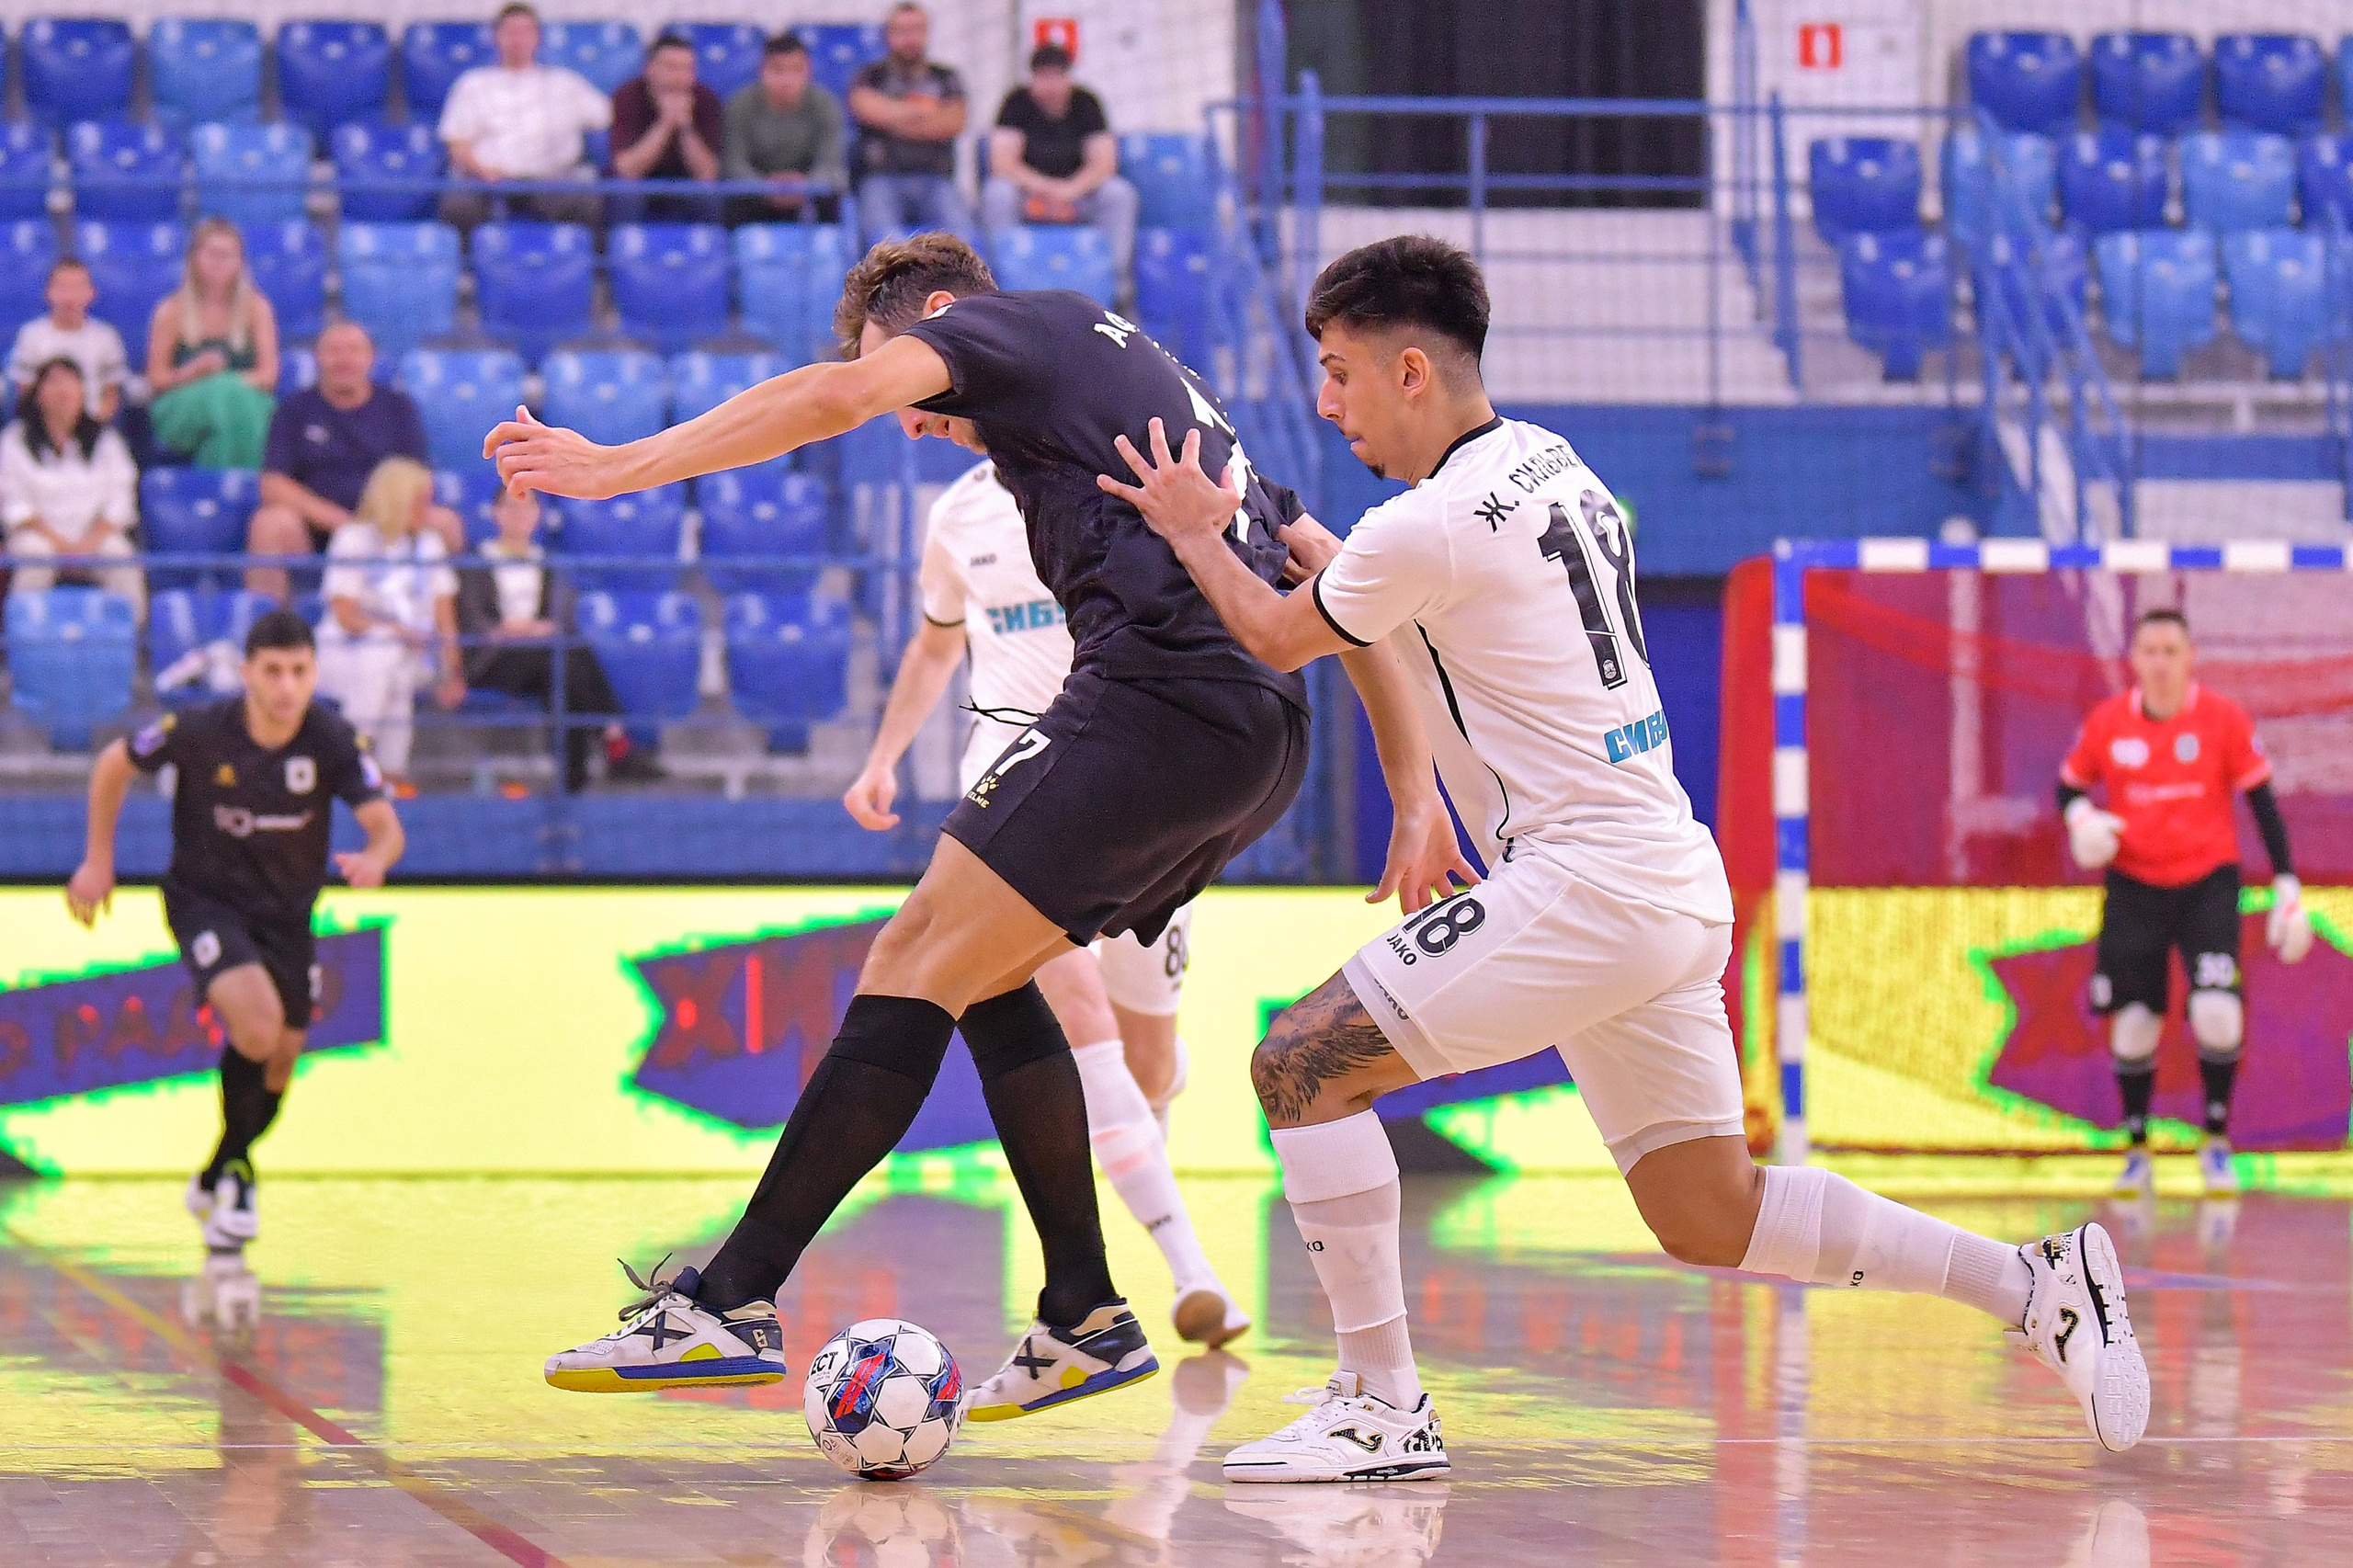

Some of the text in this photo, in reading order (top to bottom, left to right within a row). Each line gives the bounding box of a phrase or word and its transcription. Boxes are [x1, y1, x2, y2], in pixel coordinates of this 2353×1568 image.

[1472, 442, 1582, 533] Ж. СИЛЬВЕ
[1537, 502, 1651, 690] 18
[1386, 933, 1417, 966] JAKO
[1401, 891, 1486, 958] 18
